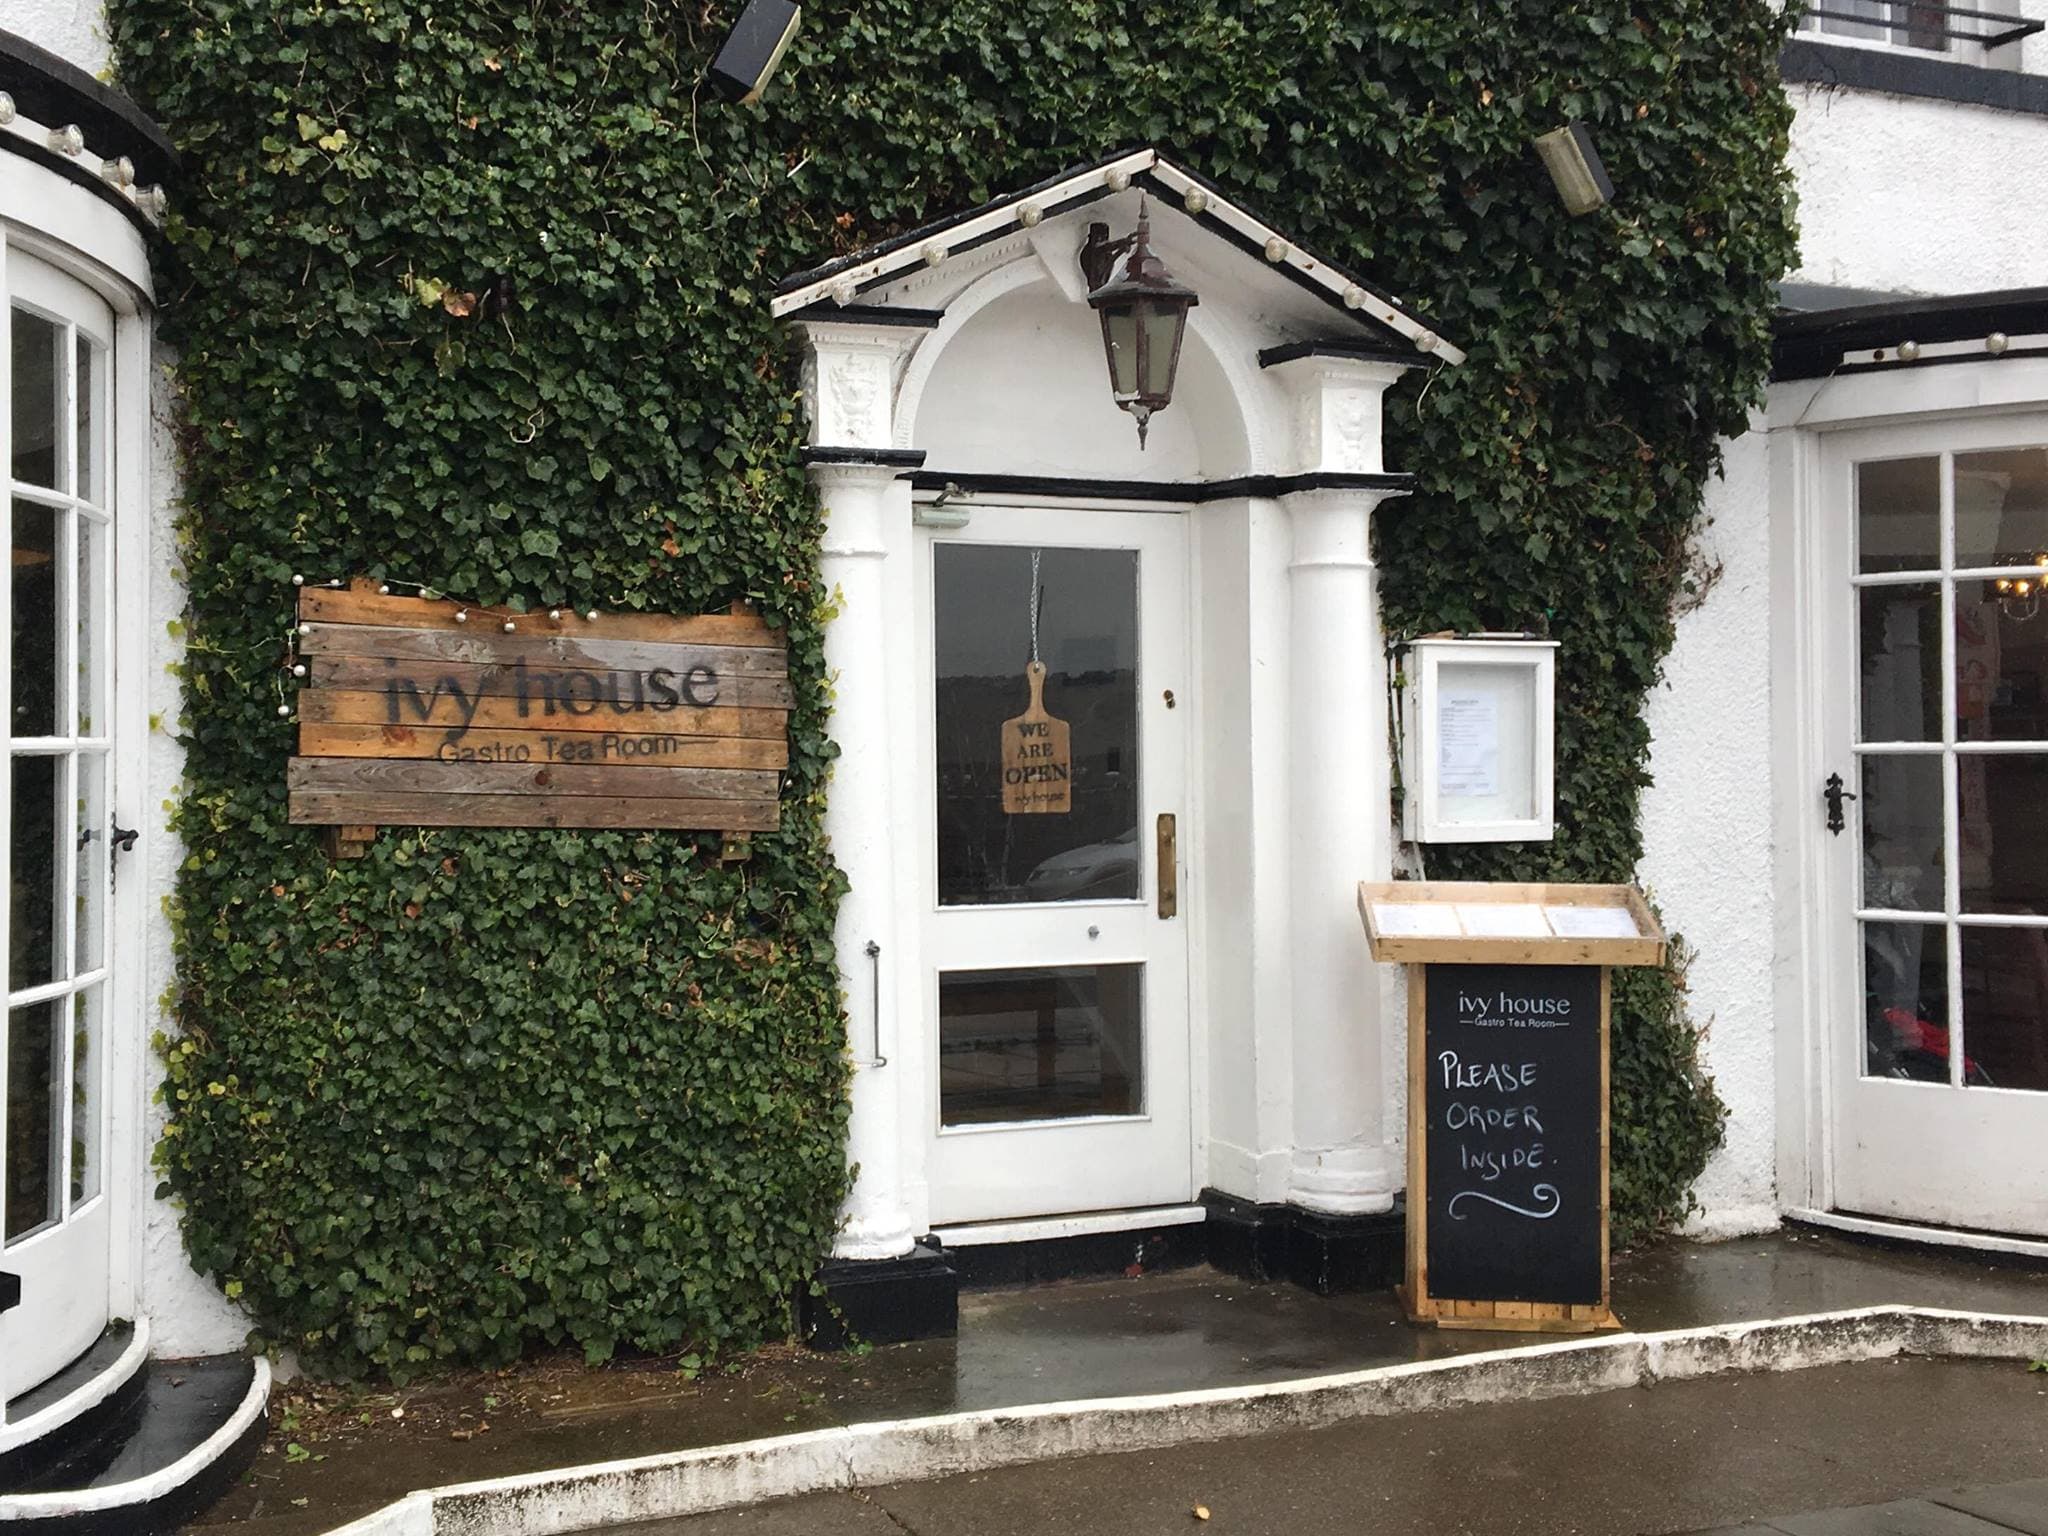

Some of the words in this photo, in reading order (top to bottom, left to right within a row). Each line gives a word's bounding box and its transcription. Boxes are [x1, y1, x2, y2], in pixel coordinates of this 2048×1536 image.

[382, 656, 497, 739] ivy
[514, 656, 720, 719] house
[1018, 722, 1049, 738] WE
[436, 740, 530, 766] Gastro
[540, 735, 593, 762] Tea
[602, 734, 677, 760] Room
[1017, 743, 1054, 759] ARE
[1006, 763, 1067, 785] OPEN
[1459, 991, 1491, 1017] ivy
[1500, 992, 1570, 1014] house
[1474, 1018, 1505, 1028] Gastro
[1508, 1018, 1526, 1028] Tea
[1528, 1018, 1555, 1028] Room
[1439, 1050, 1537, 1092] PLEASE
[1446, 1102, 1543, 1133] ORDER
